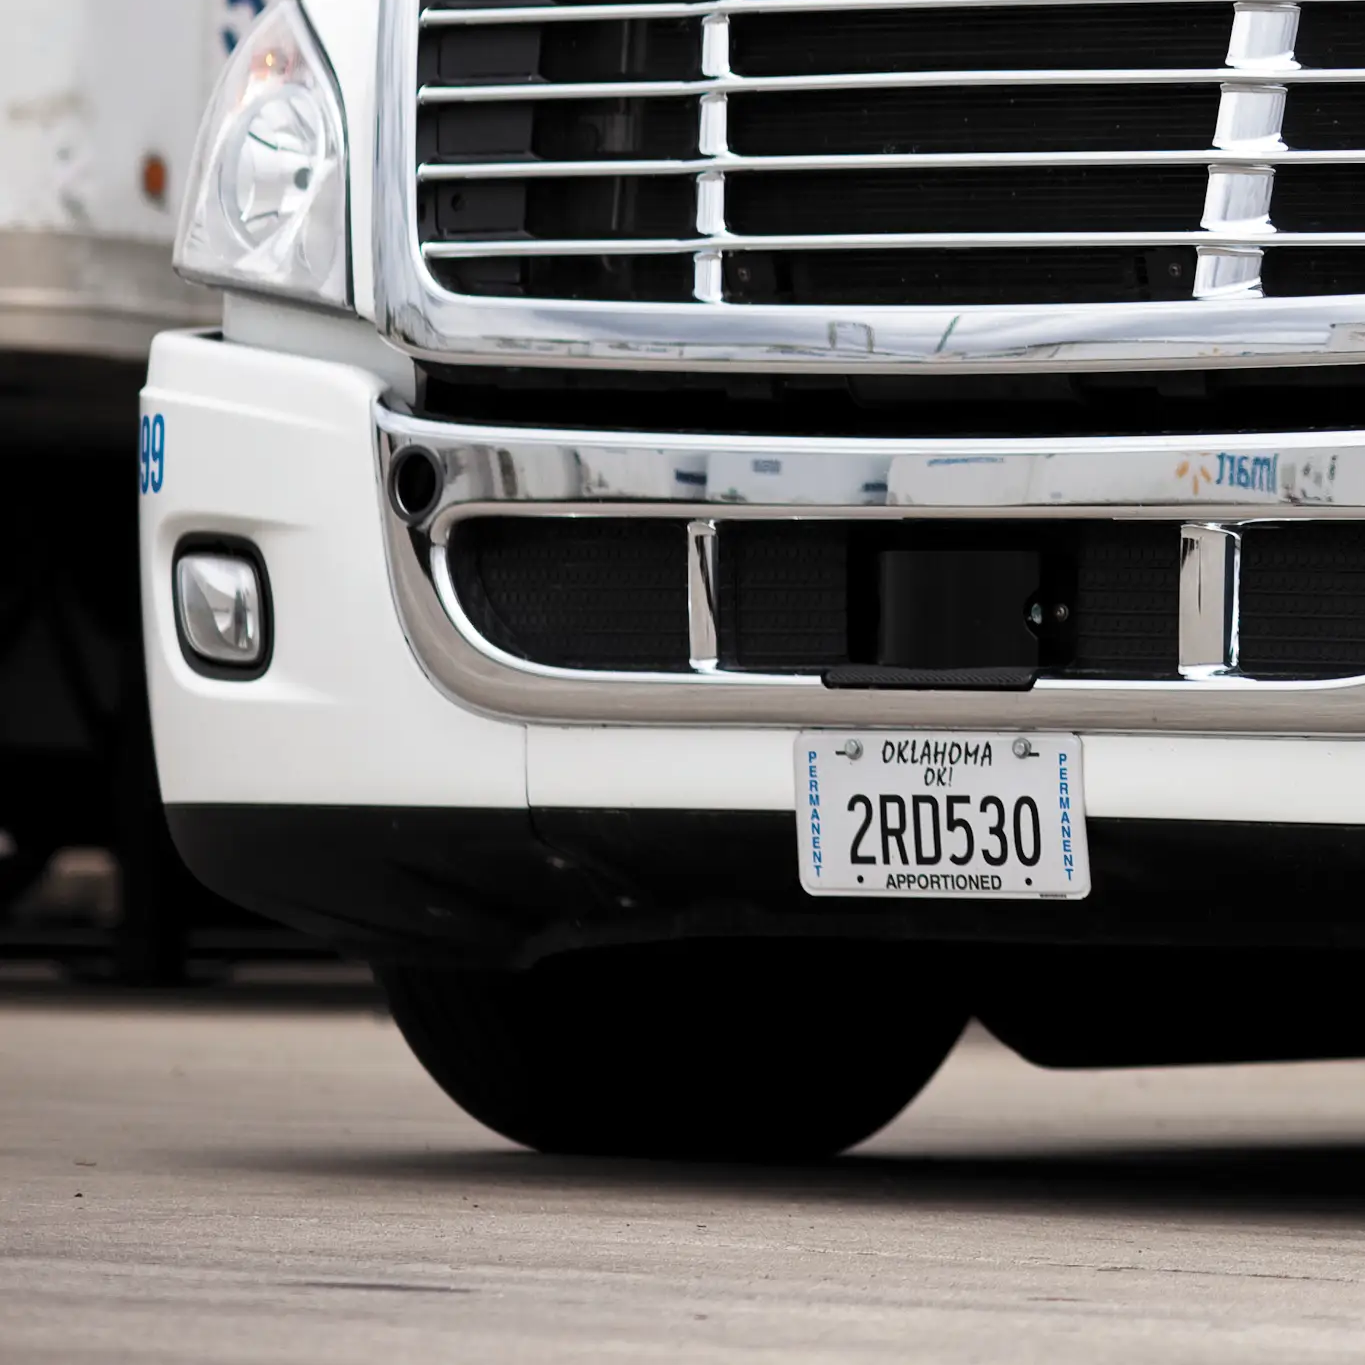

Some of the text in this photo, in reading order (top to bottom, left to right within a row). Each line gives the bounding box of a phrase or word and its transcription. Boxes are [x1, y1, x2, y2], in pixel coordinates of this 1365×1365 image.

[881, 740, 993, 767] OKLAHOMA
[924, 767, 953, 787] OK!
[807, 750, 823, 878] PERMANENT
[847, 794, 1042, 867] 2RD530
[1058, 752, 1075, 881] PERMANENT
[886, 873, 1002, 891] APPORTIONED
